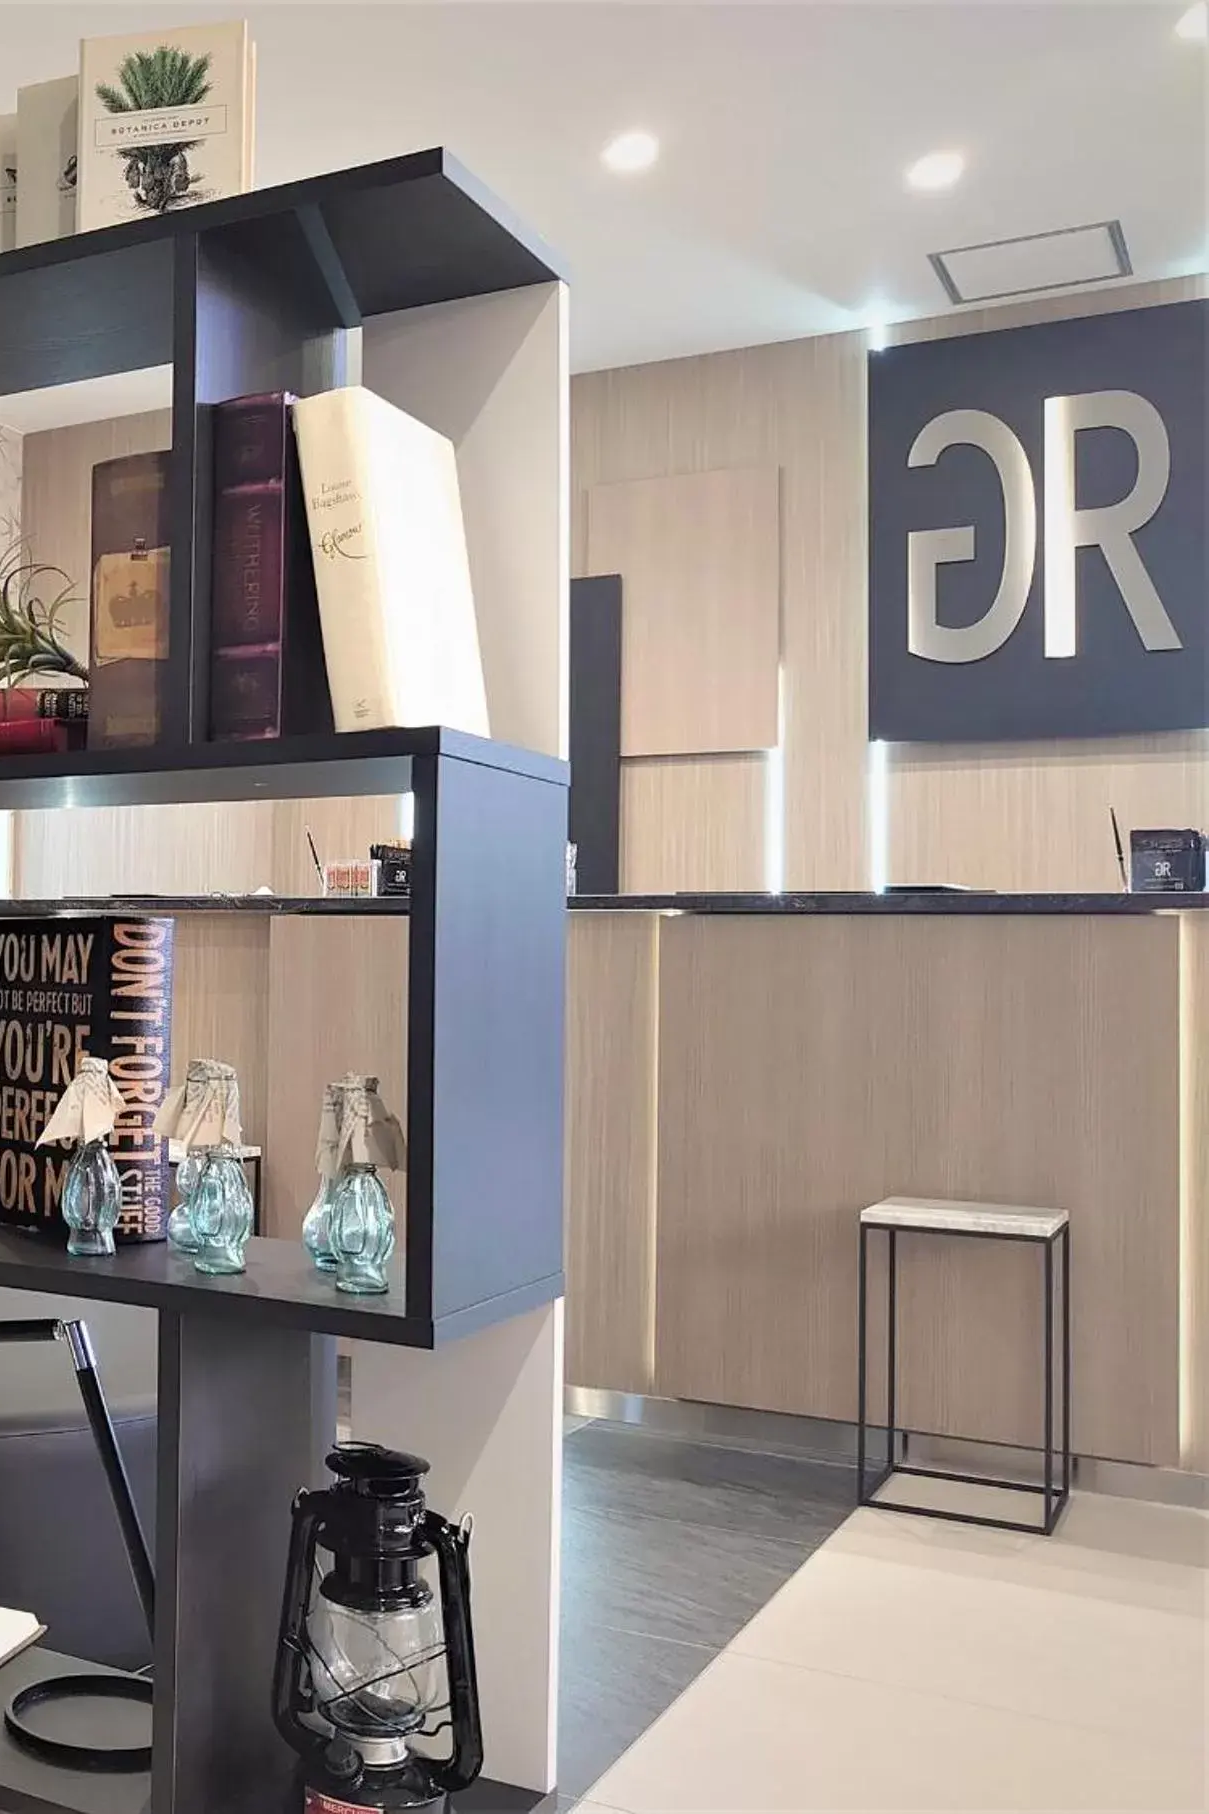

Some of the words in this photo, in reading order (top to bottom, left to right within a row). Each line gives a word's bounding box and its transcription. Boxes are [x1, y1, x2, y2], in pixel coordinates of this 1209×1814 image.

[173, 117, 210, 128] DEPOT
[41, 933, 94, 984] MAY
[11, 989, 25, 1011] BE
[26, 990, 70, 1014] PERFECT
[71, 992, 93, 1016] BUT
[107, 1036, 163, 1166] FORGET
[44, 1156, 71, 1216] M
[144, 1168, 162, 1192] THE
[144, 1197, 162, 1233] GOOD
